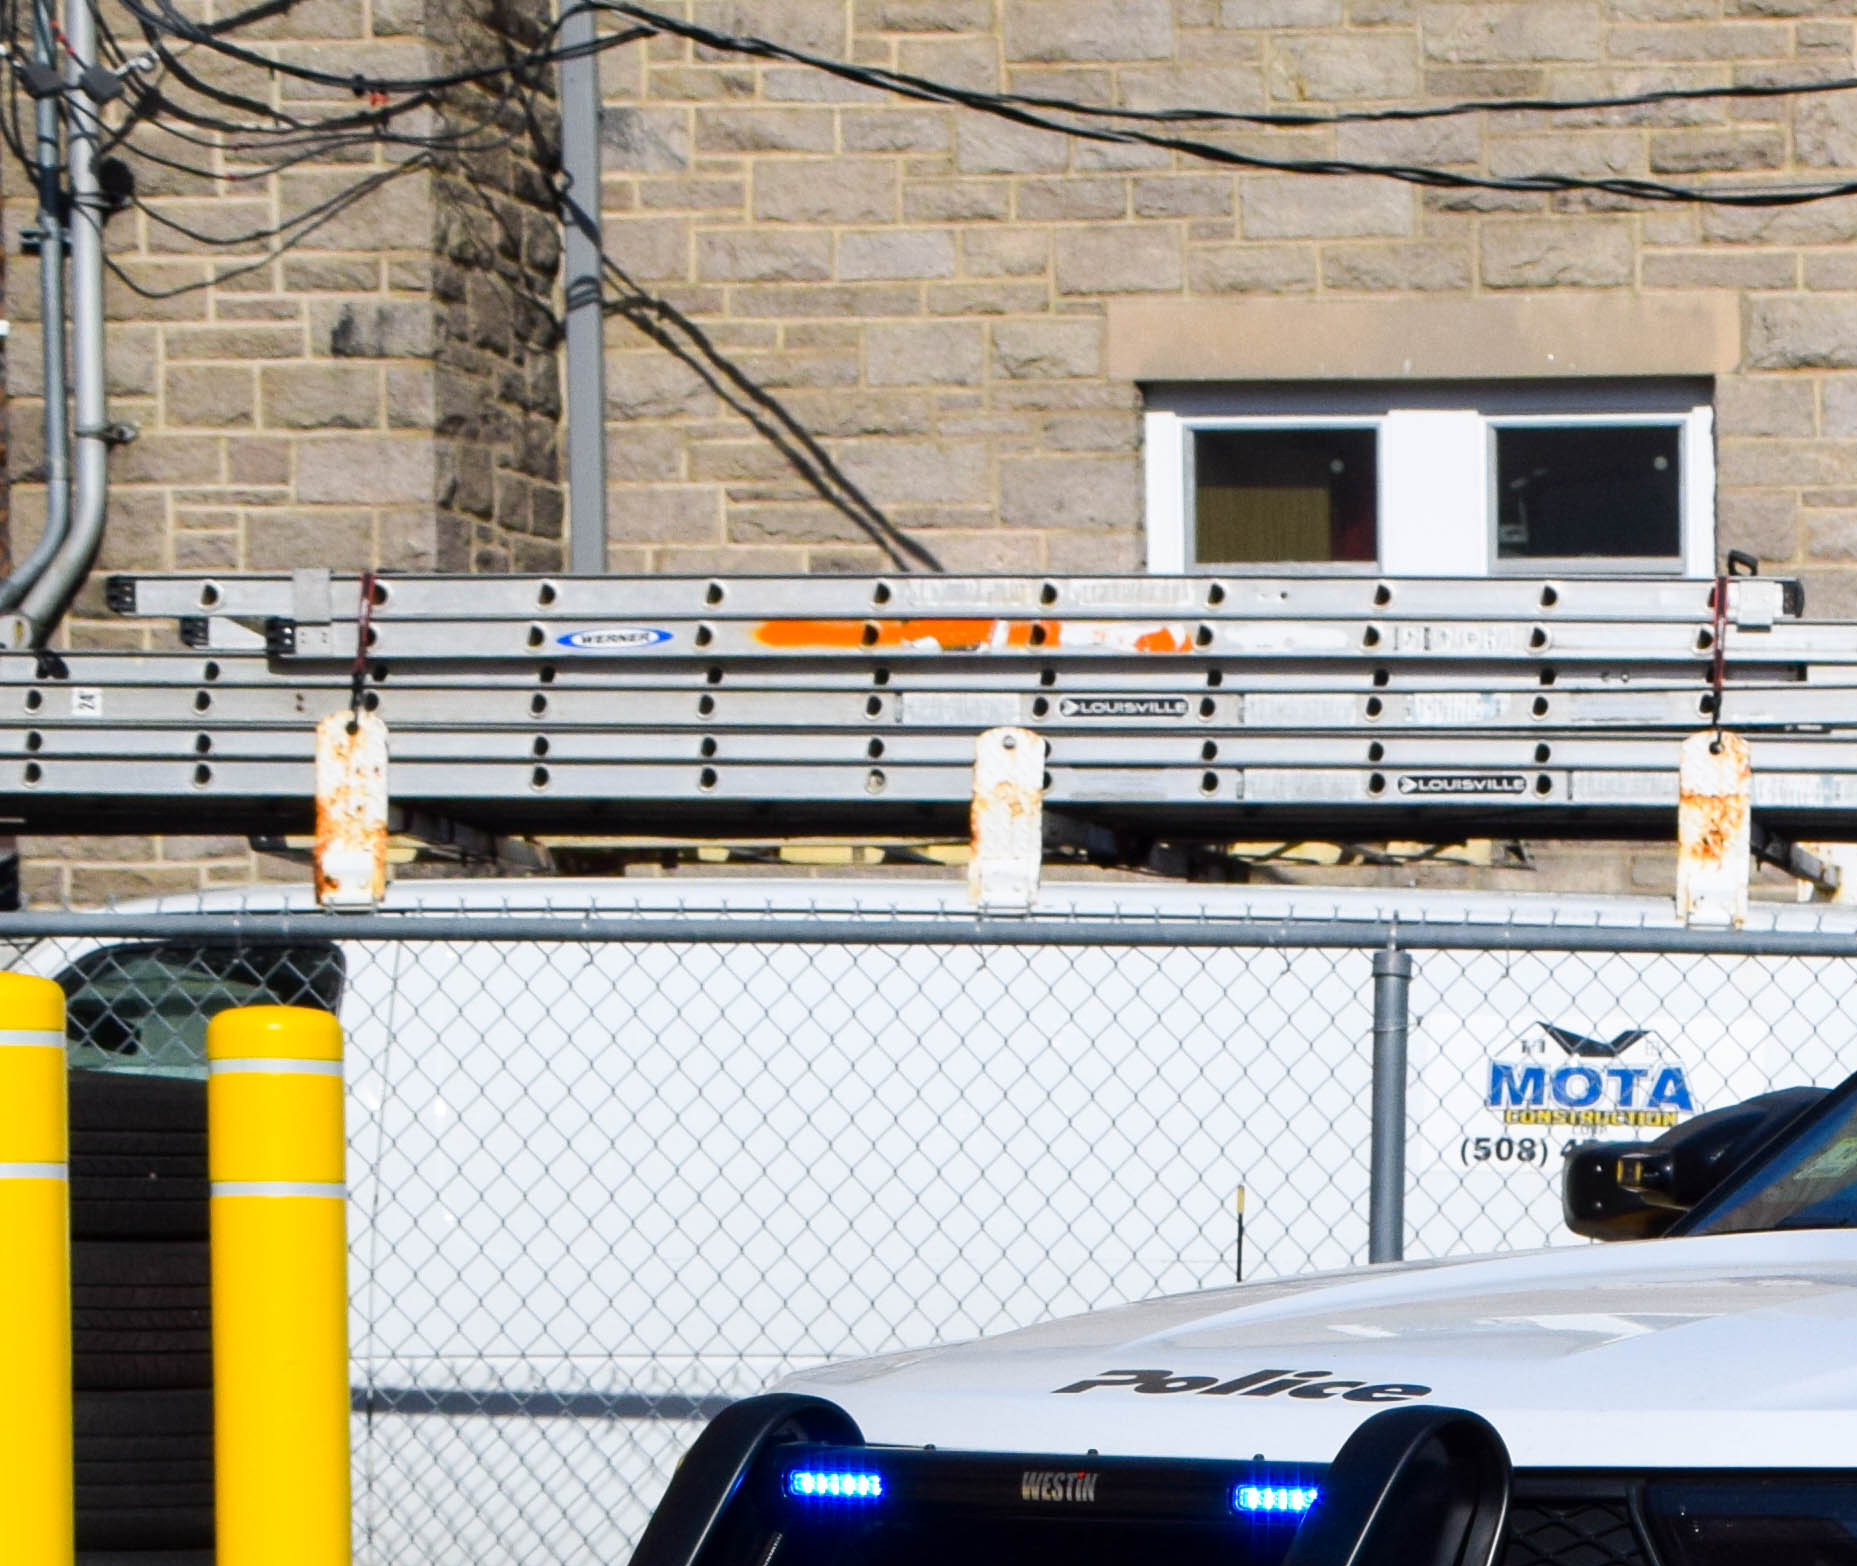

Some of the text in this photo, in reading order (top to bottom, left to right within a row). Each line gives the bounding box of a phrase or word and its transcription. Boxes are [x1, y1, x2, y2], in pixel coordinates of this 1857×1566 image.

[1080, 701, 1187, 714] LOUISVILLE
[1418, 778, 1525, 792] LOUISVILLE
[1488, 1063, 1694, 1111] MOTA
[1504, 1109, 1678, 1127] CONSTRUCTION
[1460, 1137, 1548, 1166] (508)
[1051, 1369, 1433, 1402] Police
